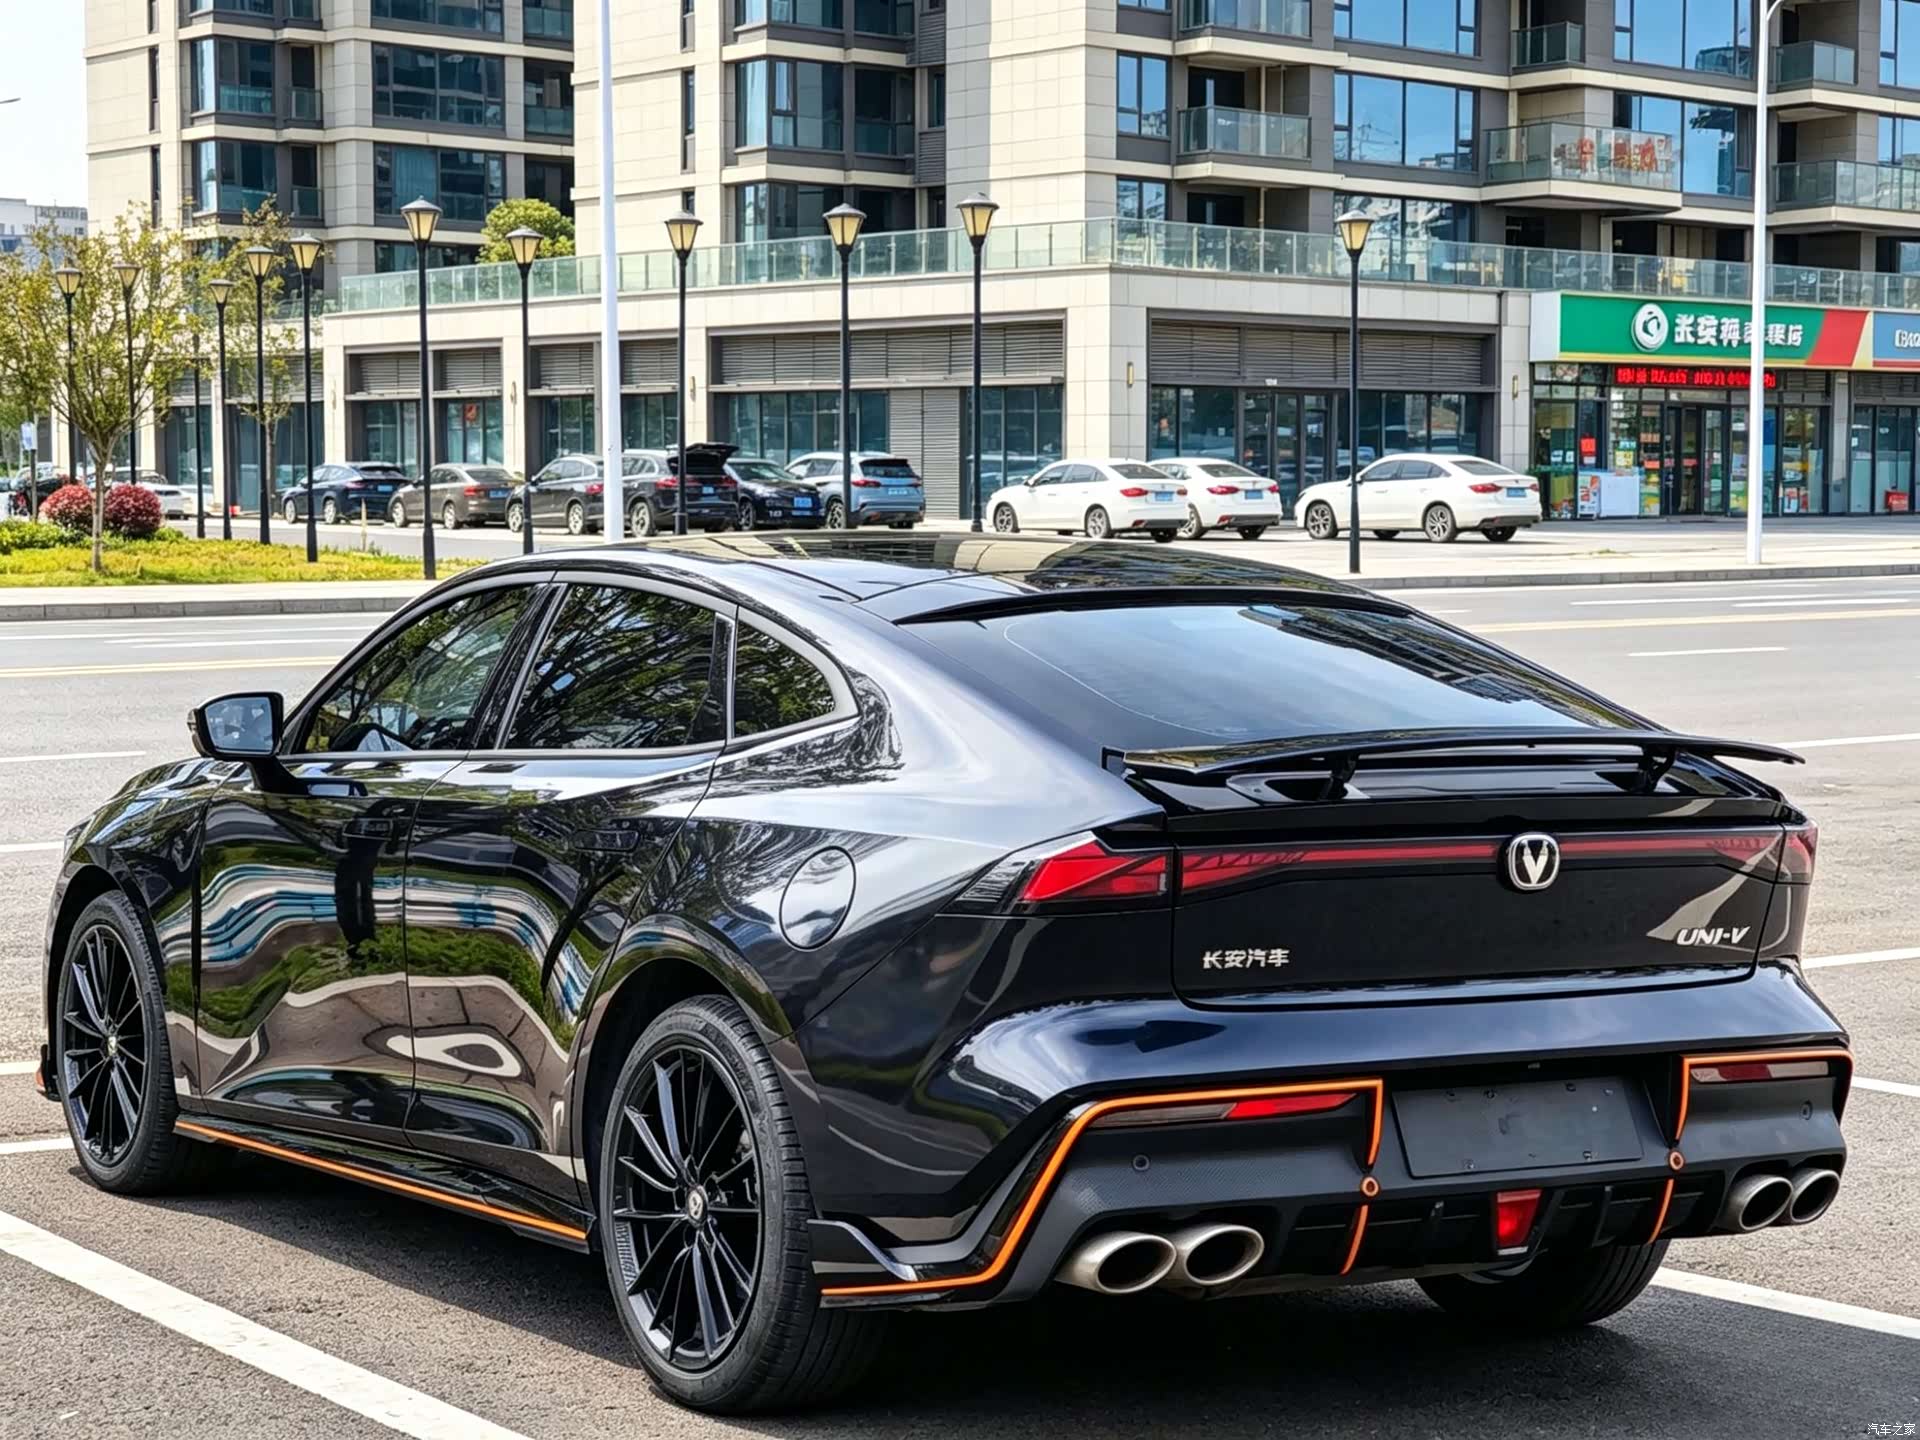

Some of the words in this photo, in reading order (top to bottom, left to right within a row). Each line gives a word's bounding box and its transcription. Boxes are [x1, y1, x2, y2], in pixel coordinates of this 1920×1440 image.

[1677, 926, 1751, 946] UNI-V
[1203, 948, 1290, 969] 长安汽车
